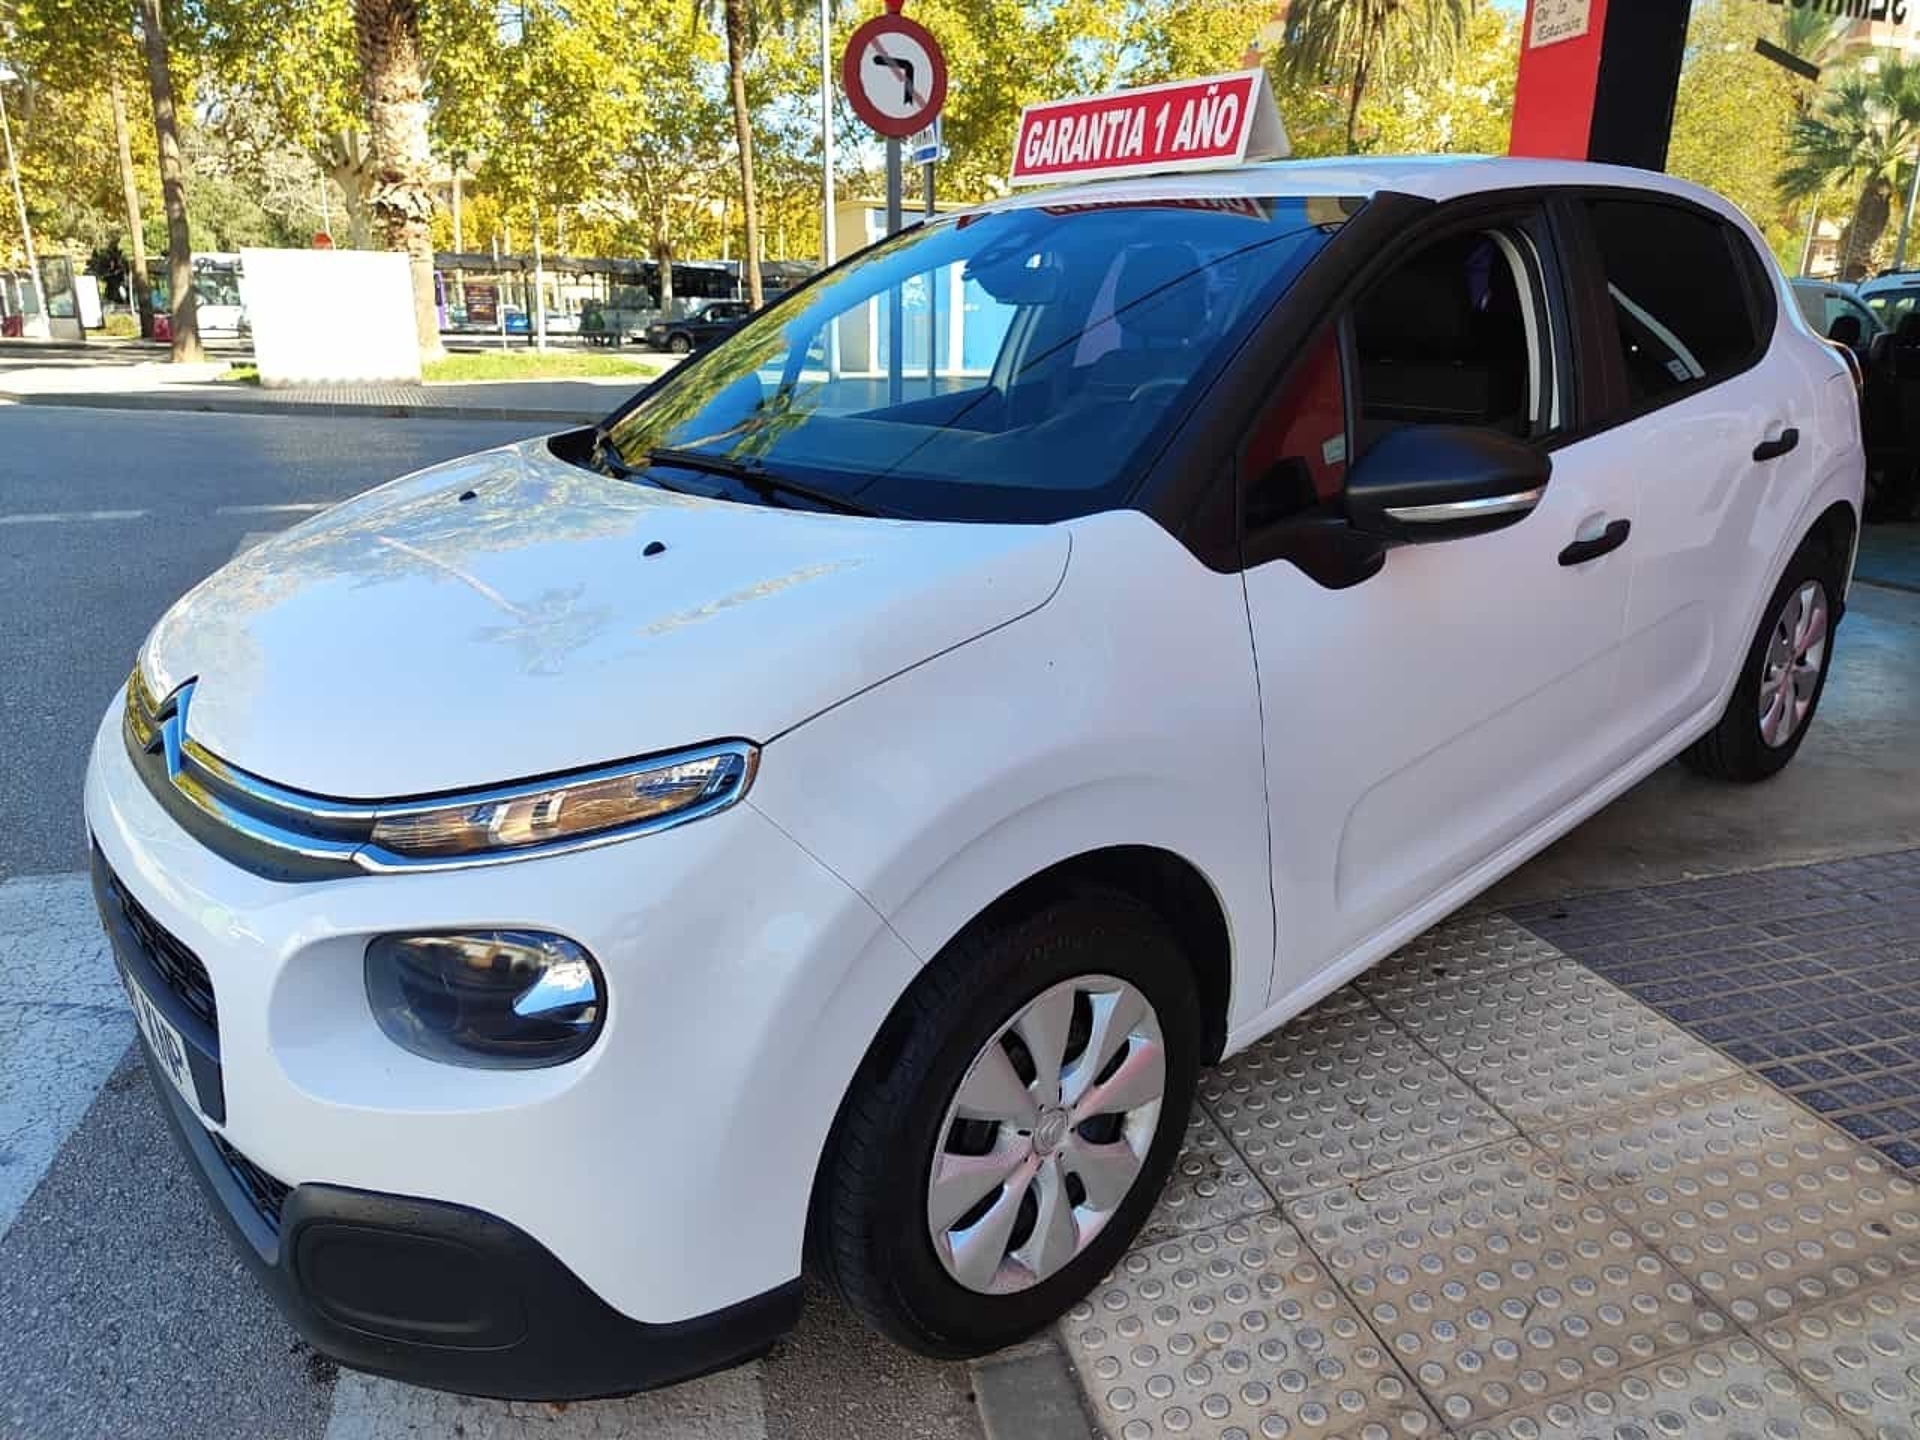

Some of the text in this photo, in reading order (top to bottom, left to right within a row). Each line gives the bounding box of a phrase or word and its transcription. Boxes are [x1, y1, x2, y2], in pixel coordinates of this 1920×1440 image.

[1023, 84, 1239, 168] GARANTIA 1 AÑO
